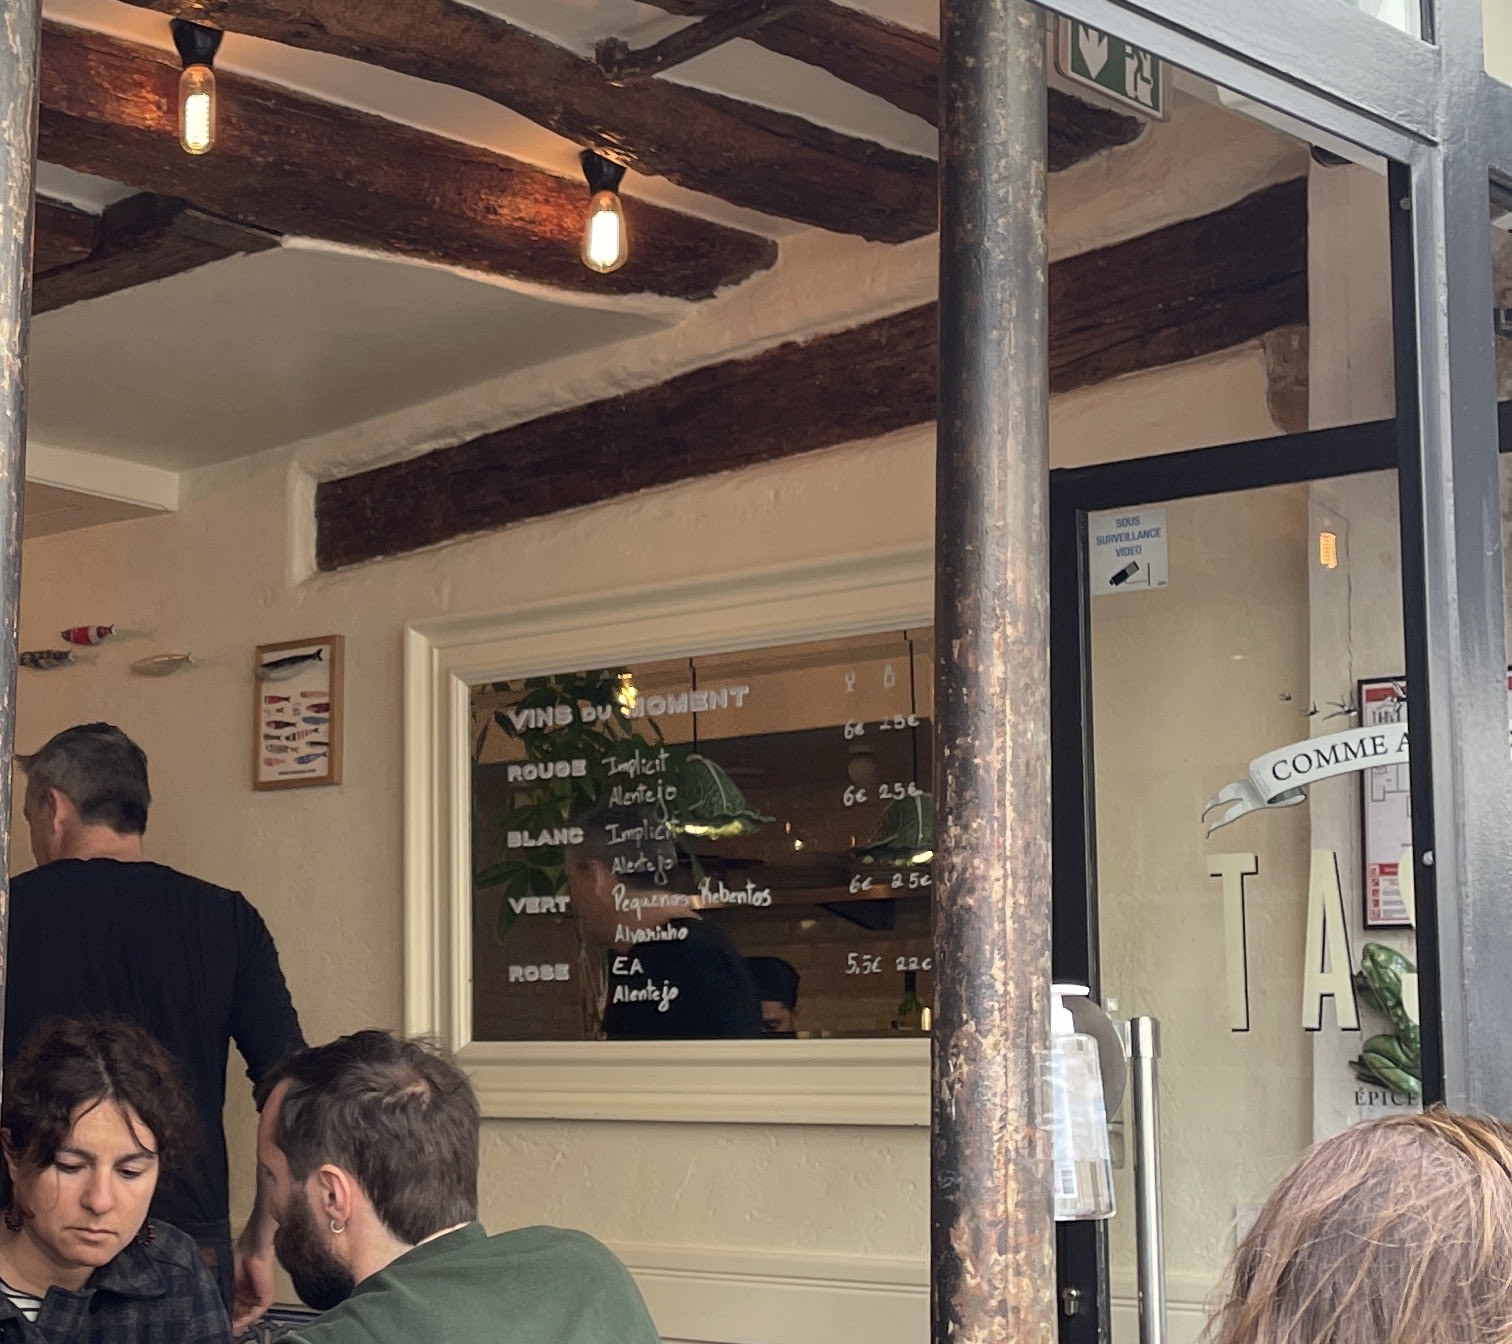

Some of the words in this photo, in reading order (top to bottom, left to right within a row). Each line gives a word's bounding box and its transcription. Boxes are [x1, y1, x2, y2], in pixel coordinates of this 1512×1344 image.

[1115, 516, 1141, 529] SOUS
[1096, 528, 1162, 546] SURVEILLANCE
[1115, 545, 1142, 558] VIDEO
[508, 705, 573, 731] VINS
[581, 704, 613, 724] DU
[626, 685, 750, 720] MOMENT
[1272, 734, 1389, 782] COMME
[507, 759, 587, 783] ROUGE
[843, 785, 867, 807] 6€
[878, 781, 924, 801] 25€
[507, 826, 585, 849] BLANC
[849, 874, 873, 894] 6€
[891, 872, 933, 889] 25€
[508, 895, 571, 915] VERT
[612, 956, 644, 975] EA
[895, 956, 933, 971] 22€
[612, 978, 680, 1013] Alentejo
